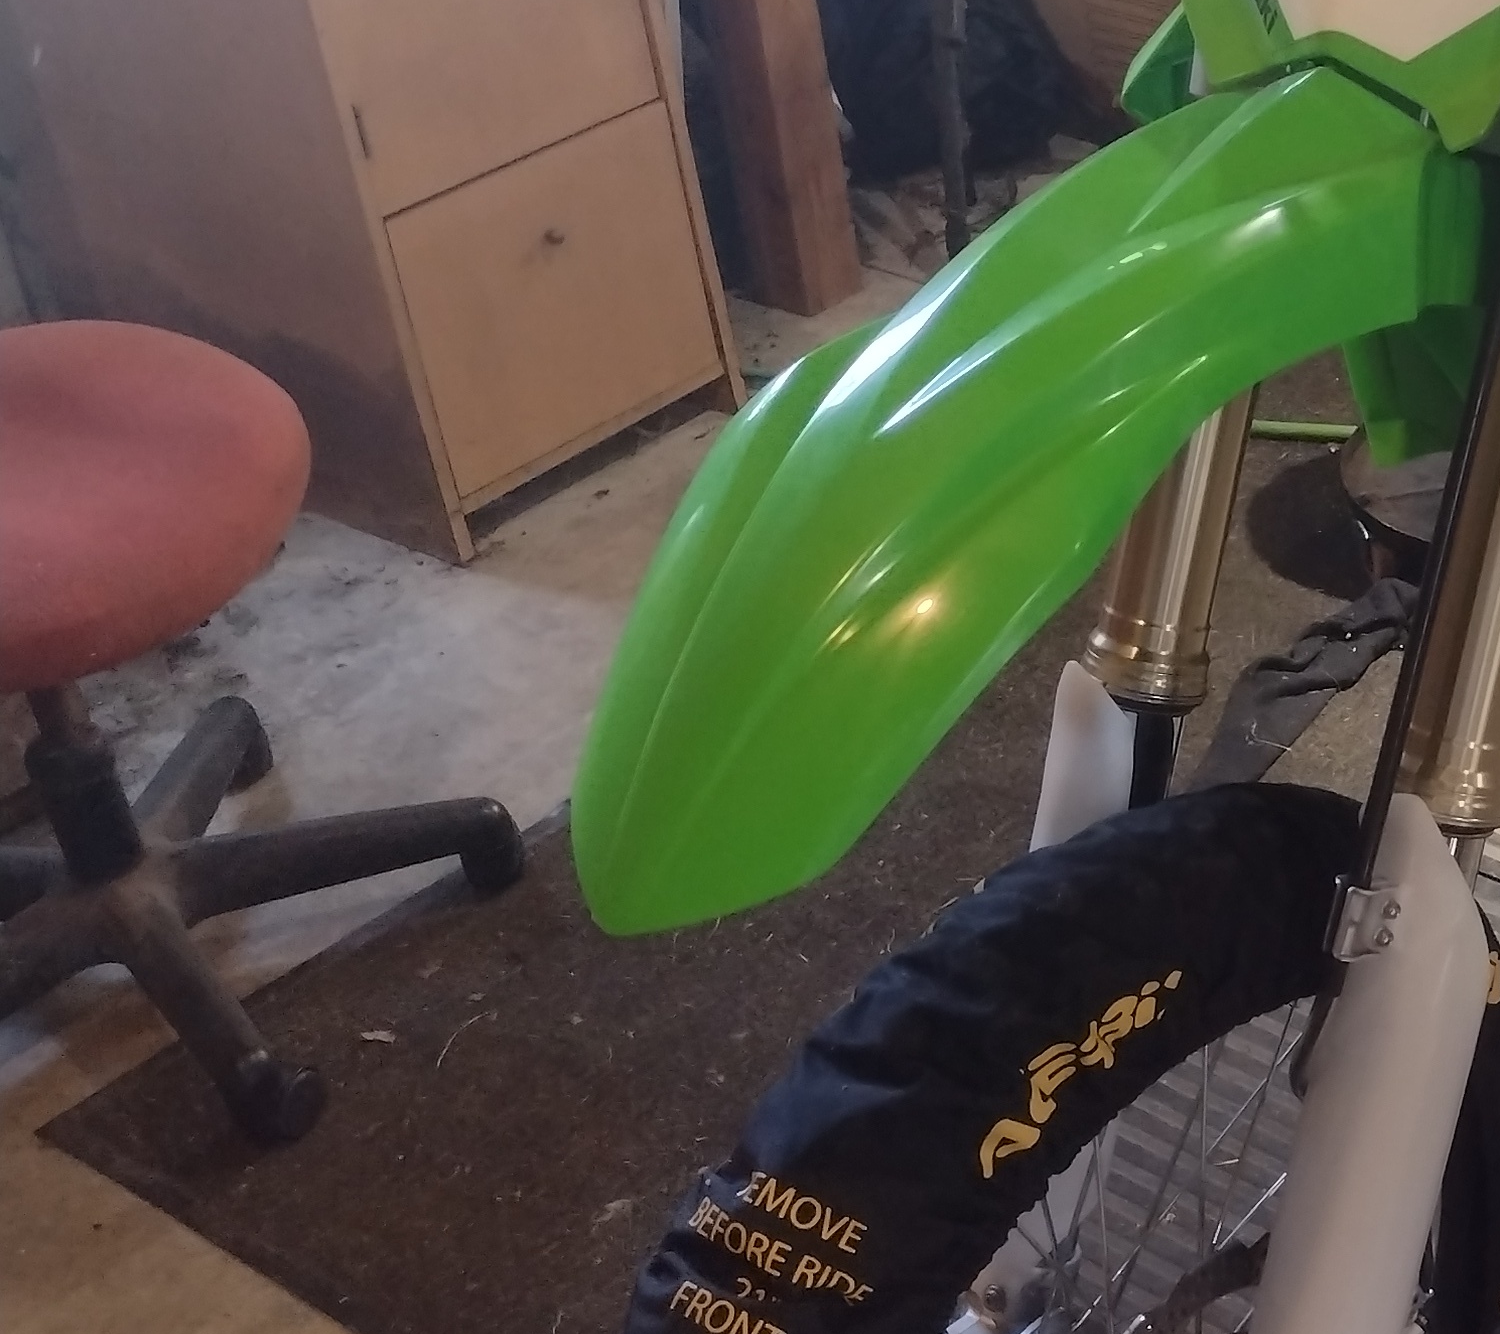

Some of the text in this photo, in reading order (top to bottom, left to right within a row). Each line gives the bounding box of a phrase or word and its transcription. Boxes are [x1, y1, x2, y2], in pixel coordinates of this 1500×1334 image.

[688, 1195, 874, 1307] BEFORE RIDE
[735, 1170, 868, 1254] EMOVE
